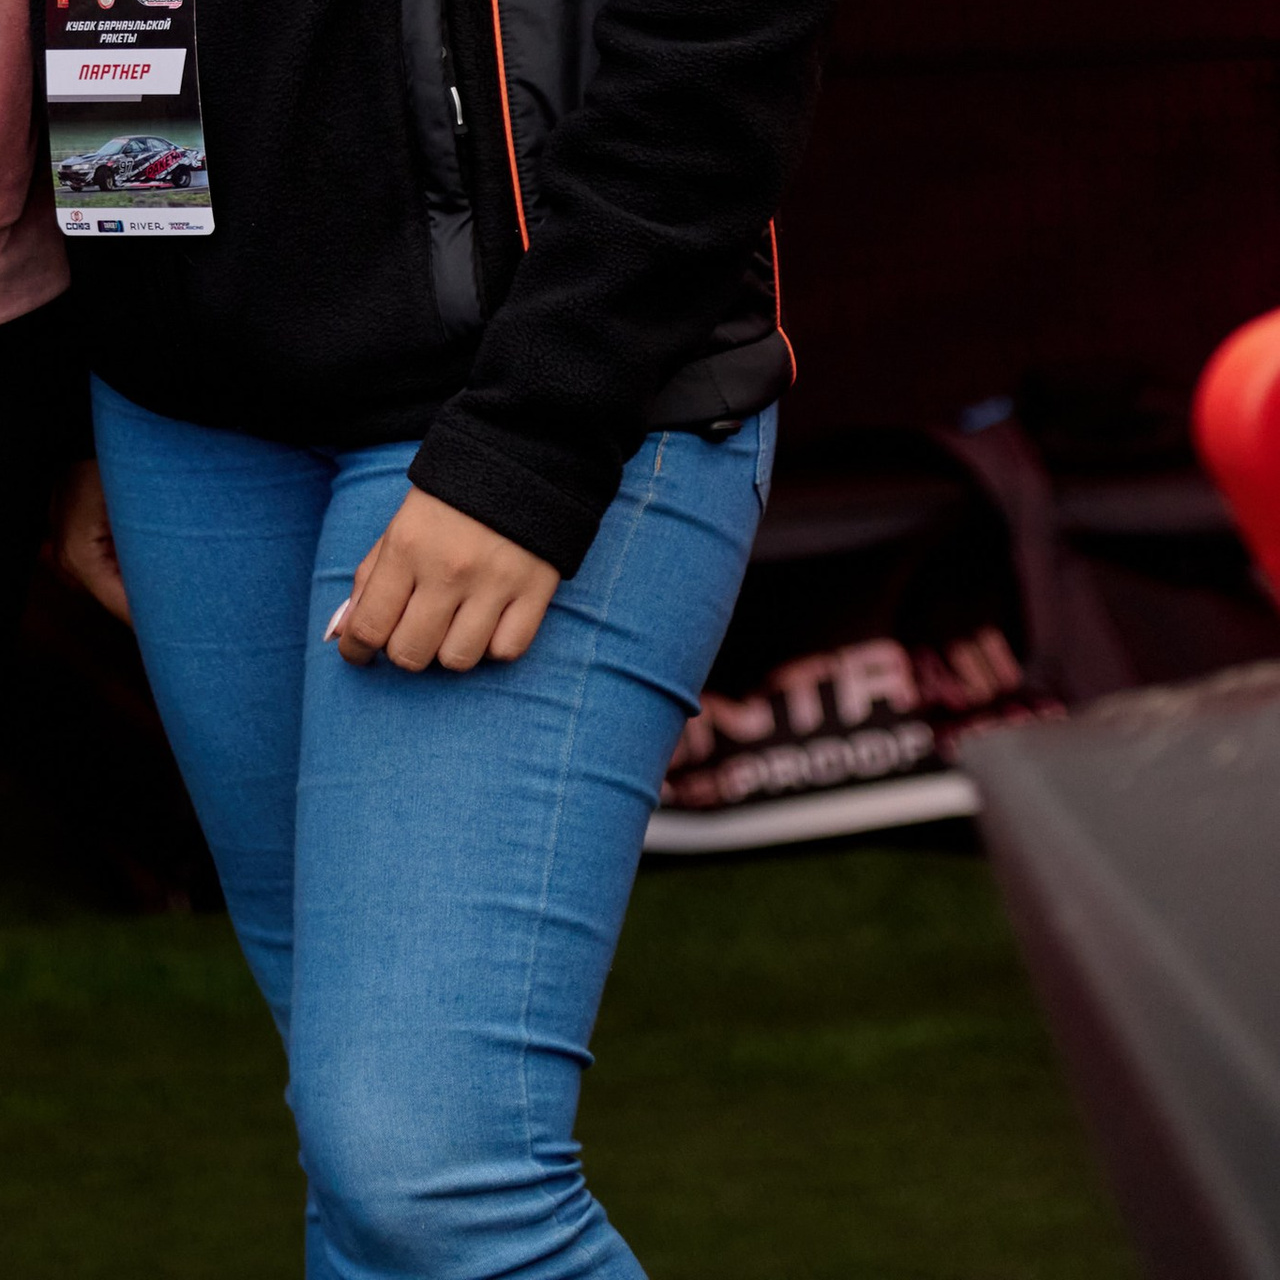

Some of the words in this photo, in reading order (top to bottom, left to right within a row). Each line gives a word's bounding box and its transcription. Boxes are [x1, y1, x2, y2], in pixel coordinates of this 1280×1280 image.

[66, 20, 97, 31] КУБОК
[98, 18, 171, 31] БАРНАУЛЬСКОЙ
[100, 33, 137, 43] РАКЕТЫ
[78, 64, 151, 80] ПАРТНЕР
[130, 222, 164, 230] RIVER
